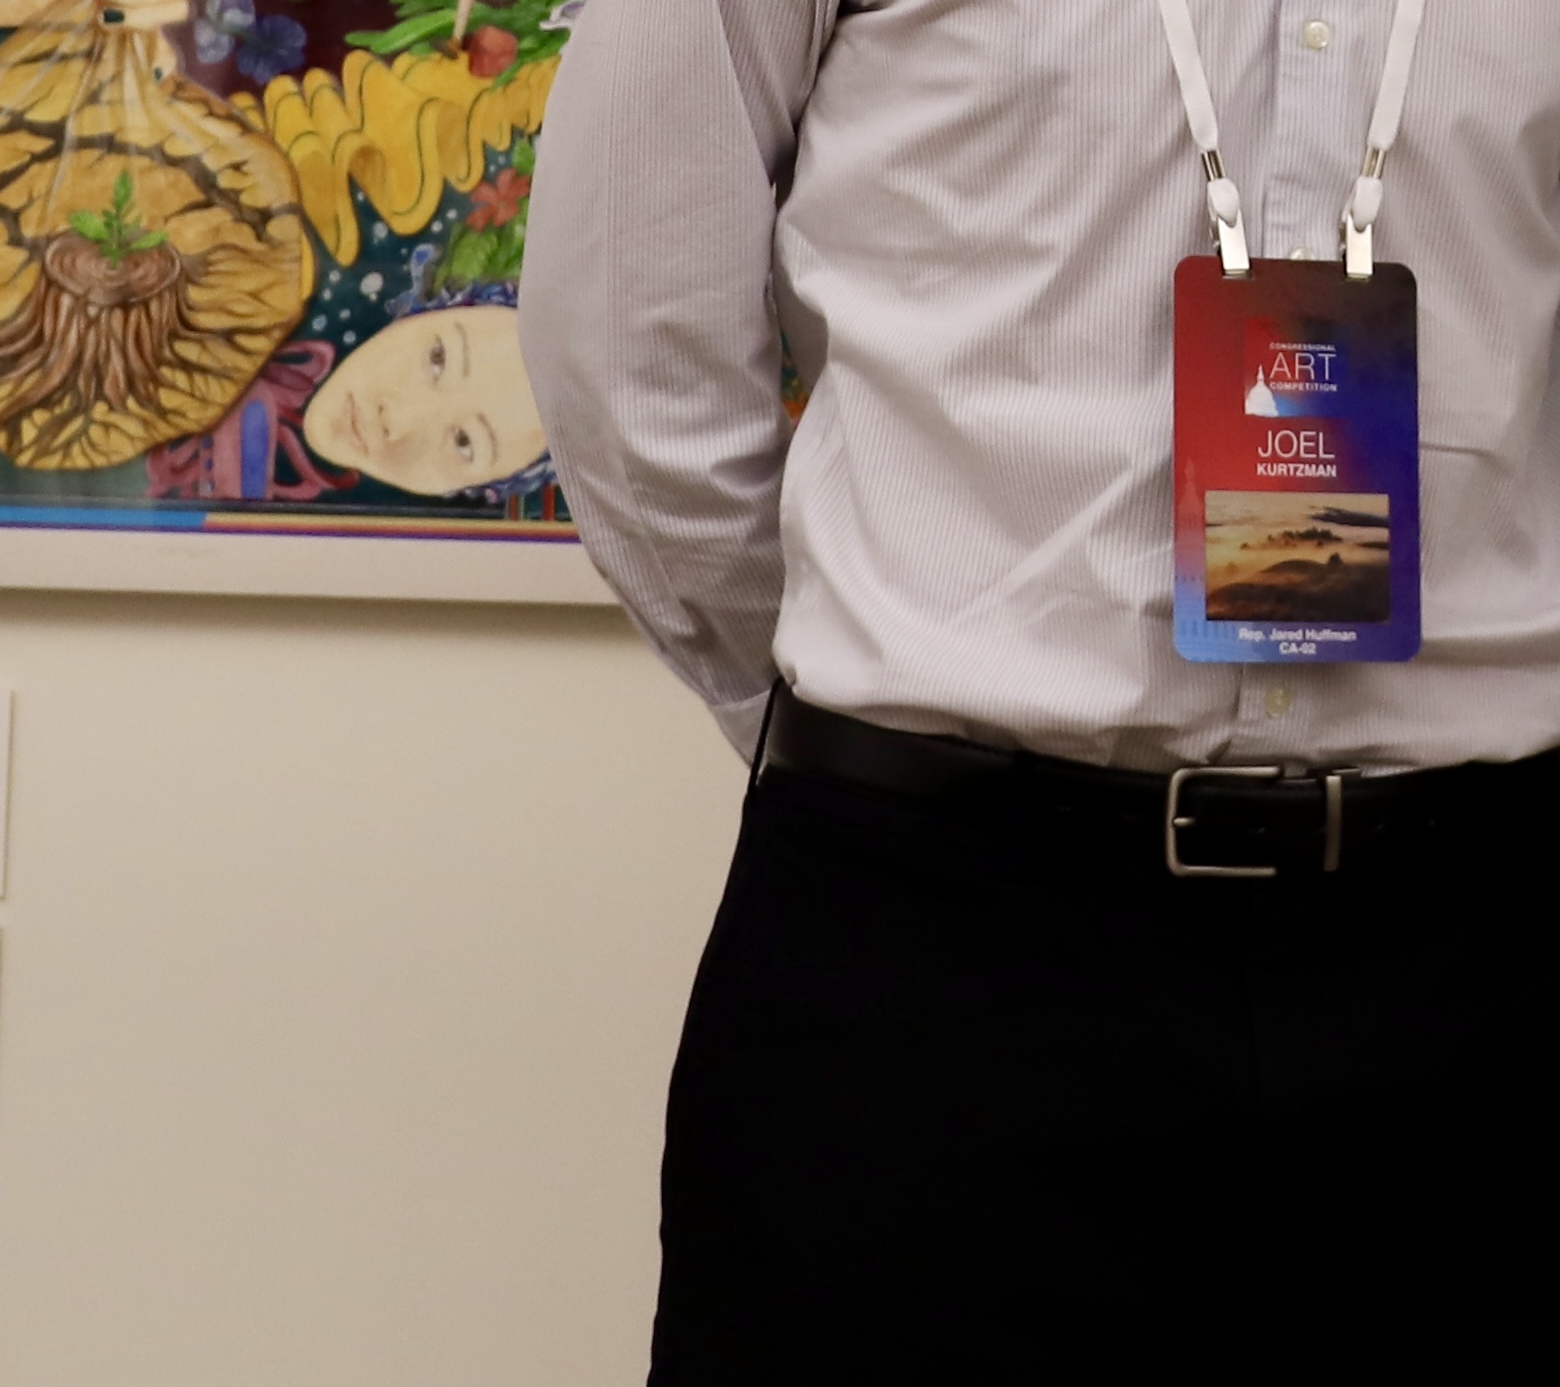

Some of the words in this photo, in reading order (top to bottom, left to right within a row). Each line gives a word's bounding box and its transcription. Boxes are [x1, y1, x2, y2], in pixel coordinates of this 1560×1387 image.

[1269, 342, 1336, 351] CONGRESSIONAL
[1270, 352, 1336, 380] ART
[1270, 382, 1338, 392] COMPETITION
[1258, 430, 1335, 458] JOEL
[1256, 463, 1336, 477] KURTZMAN
[1238, 627, 1266, 642] Rep.
[1271, 628, 1303, 641] Jared
[1305, 629, 1357, 641] Huffman
[1279, 642, 1316, 655] CA-02
